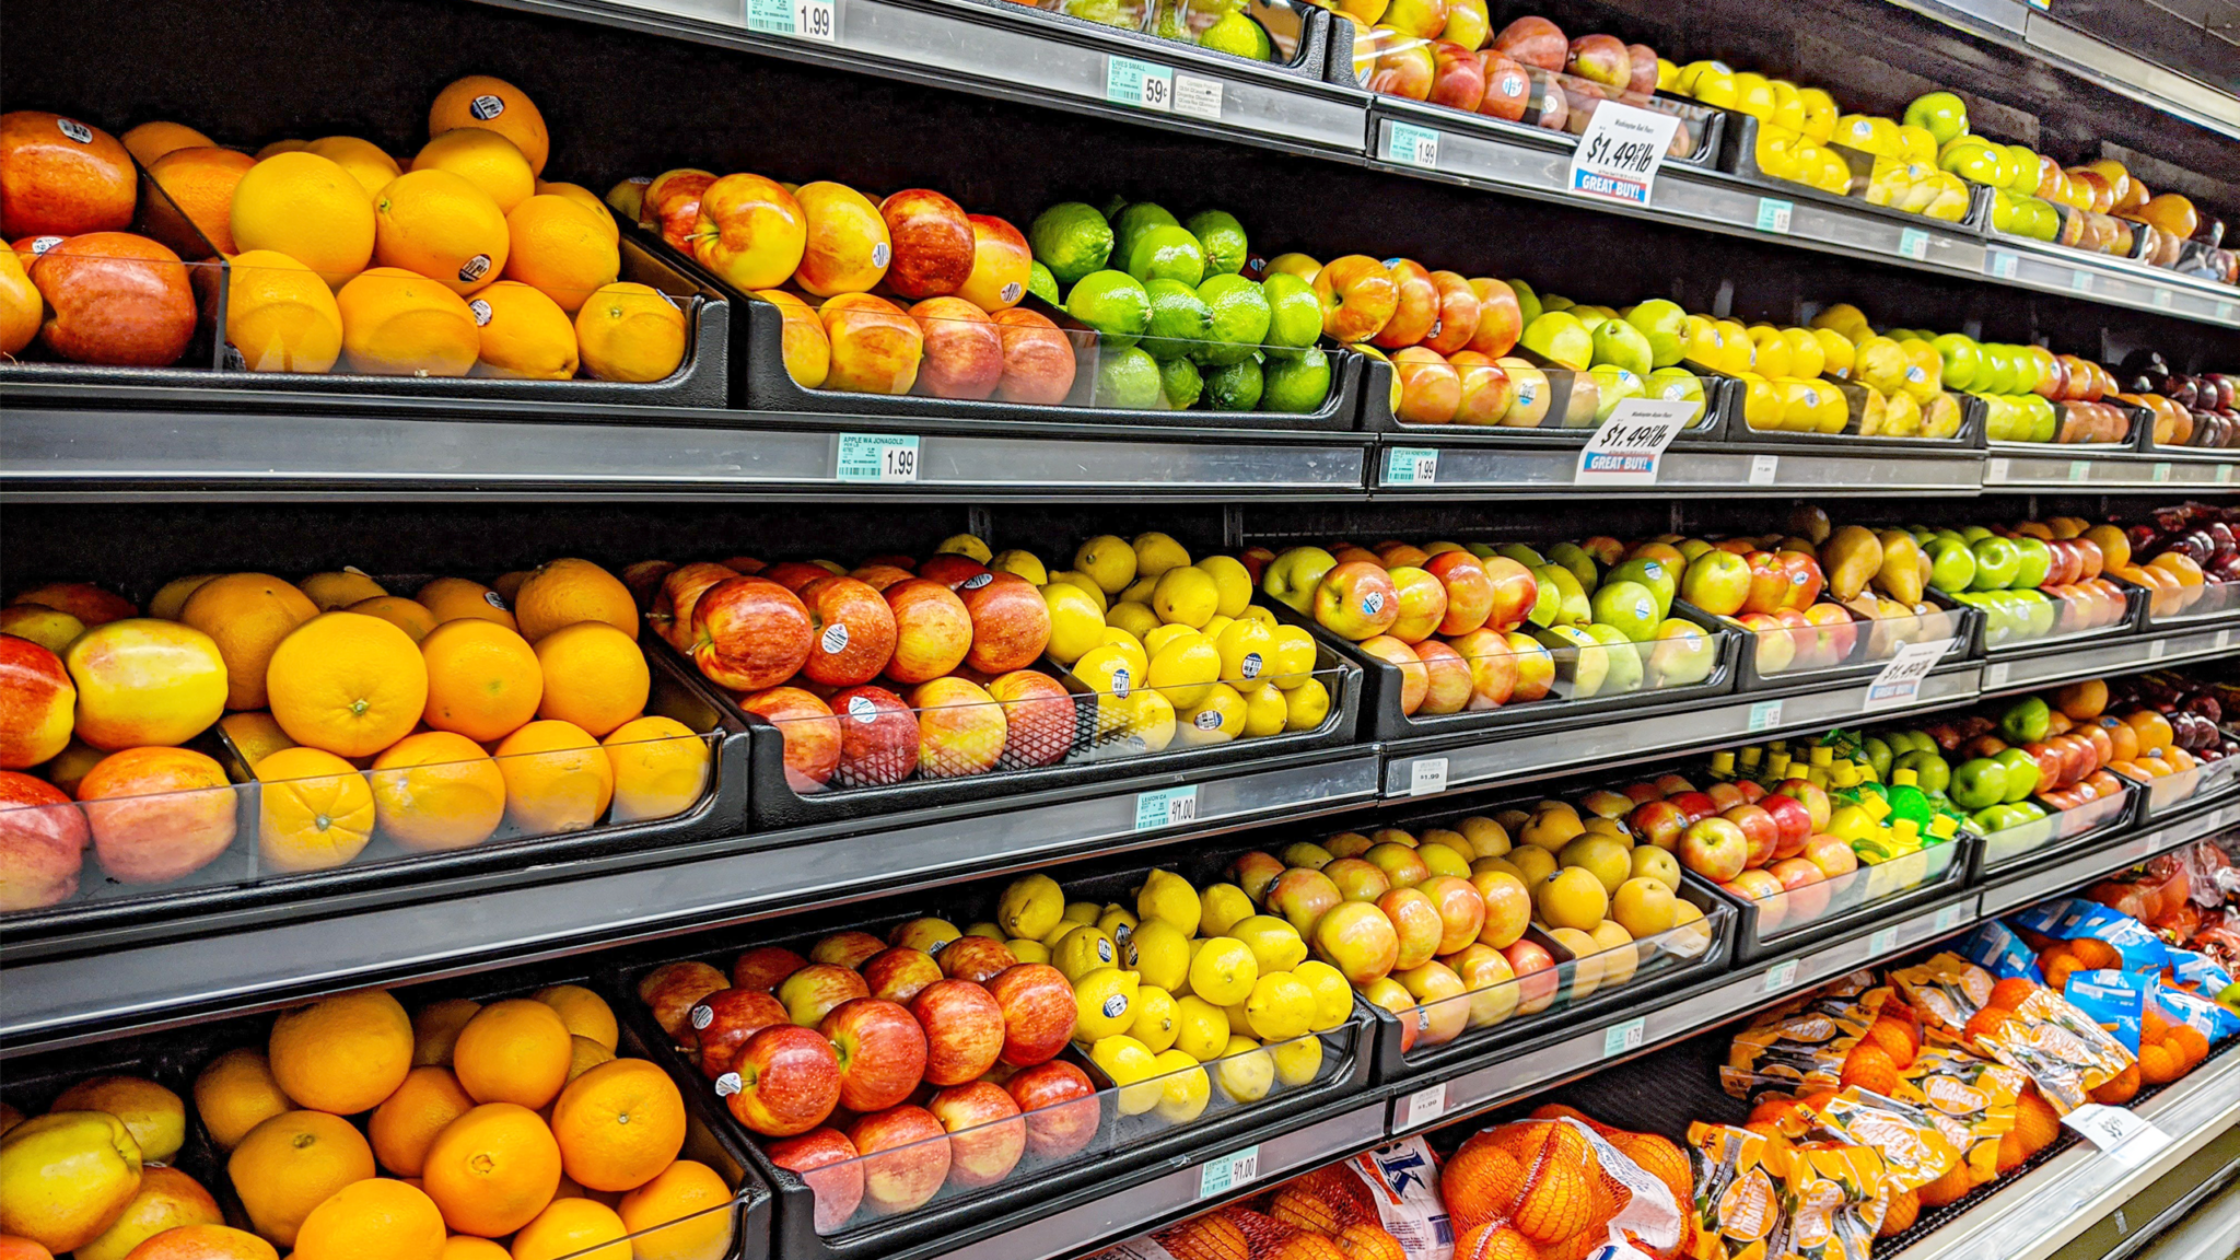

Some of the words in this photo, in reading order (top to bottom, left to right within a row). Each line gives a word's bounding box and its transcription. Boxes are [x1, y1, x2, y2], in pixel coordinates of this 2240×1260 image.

[801, 5, 829, 36] 1.99
[1419, 142, 1435, 164] 1.99
[1587, 132, 1637, 169] $1.49
[1582, 174, 1616, 194] GREAT
[1616, 182, 1641, 199] BUY!
[844, 436, 862, 444] APPLE
[1600, 423, 1653, 448] $1.49
[888, 450, 914, 475] 1.99
[1418, 460, 1434, 479] 1.99
[1590, 455, 1623, 470] GREAT
[1624, 456, 1649, 471] BUY!
